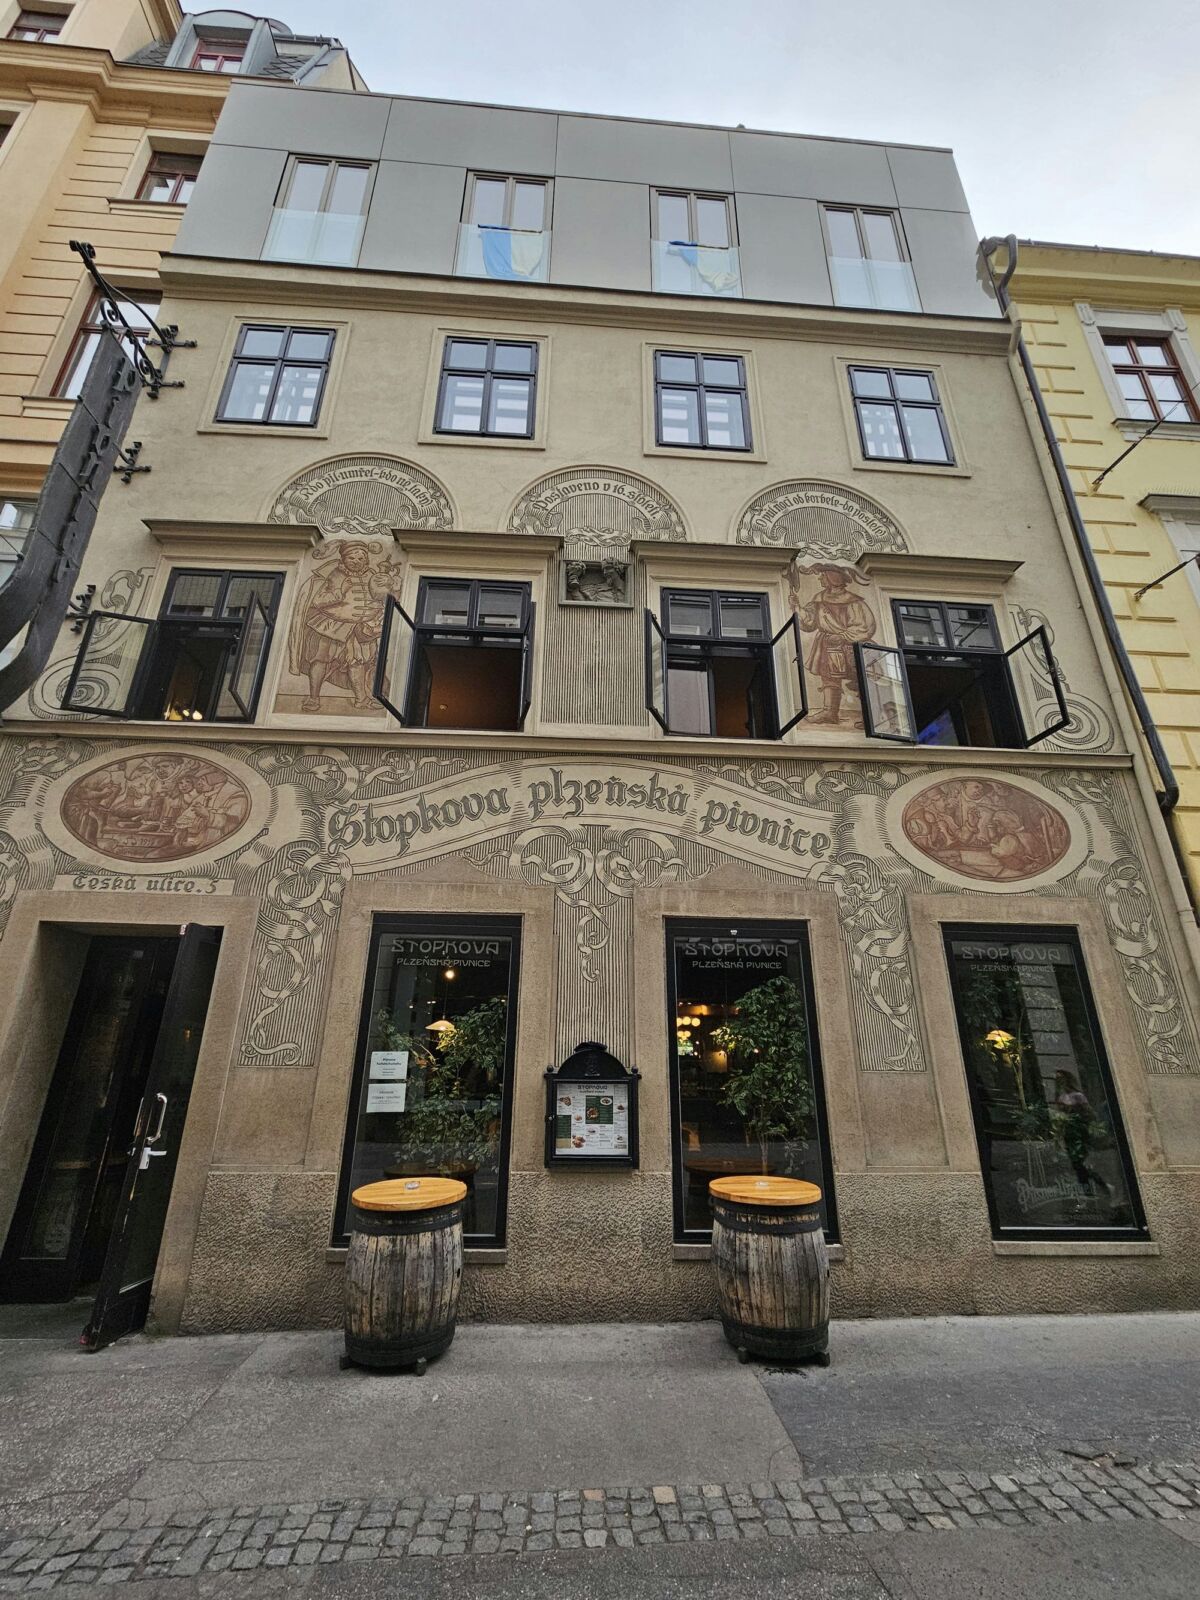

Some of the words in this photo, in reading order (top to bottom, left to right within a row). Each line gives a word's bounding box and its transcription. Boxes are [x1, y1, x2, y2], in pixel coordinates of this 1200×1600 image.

[532, 481, 599, 512] Postaveno
[603, 482, 611, 492] v
[755, 517, 768, 528] O
[792, 493, 805, 505] od
[328, 785, 511, 855] Stopkova
[527, 768, 688, 822] plzeňská
[700, 798, 832, 858] pivnice
[72, 872, 136, 891] Česká
[391, 939, 499, 955] STOPKOVA
[685, 943, 788, 957] STOPKOVA
[961, 946, 1060, 961] STOPKOVA
[397, 956, 451, 967] PLZEŇSKÁ
[453, 959, 491, 967] PIVNICE
[692, 958, 743, 969] PLZEŇSKÁ
[746, 961, 782, 969] PIVNICE
